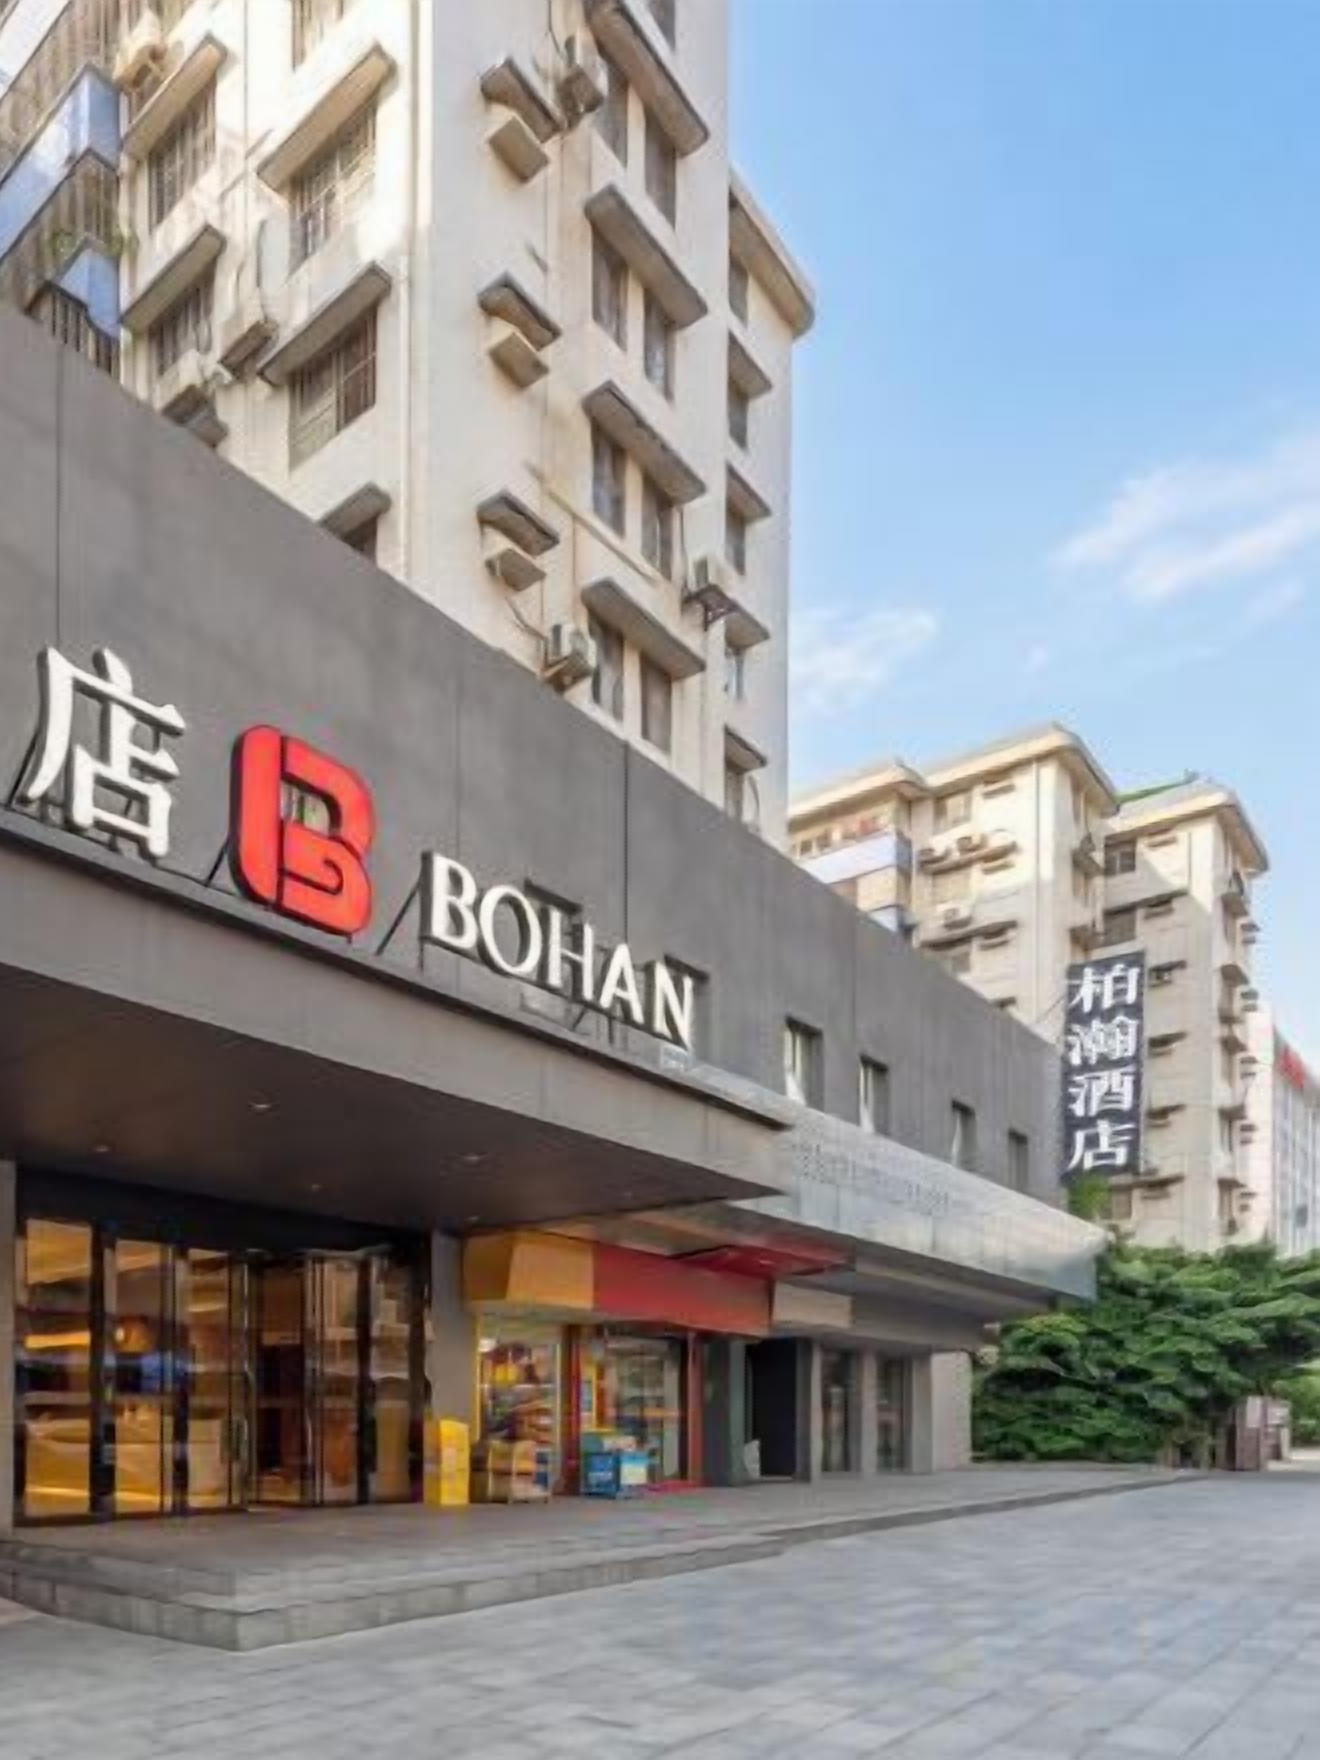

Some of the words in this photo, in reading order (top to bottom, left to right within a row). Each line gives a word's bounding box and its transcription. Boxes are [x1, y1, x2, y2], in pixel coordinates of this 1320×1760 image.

[428, 852, 694, 1048] BOHAN
[1066, 962, 1141, 1171] 柏瀚酒店
